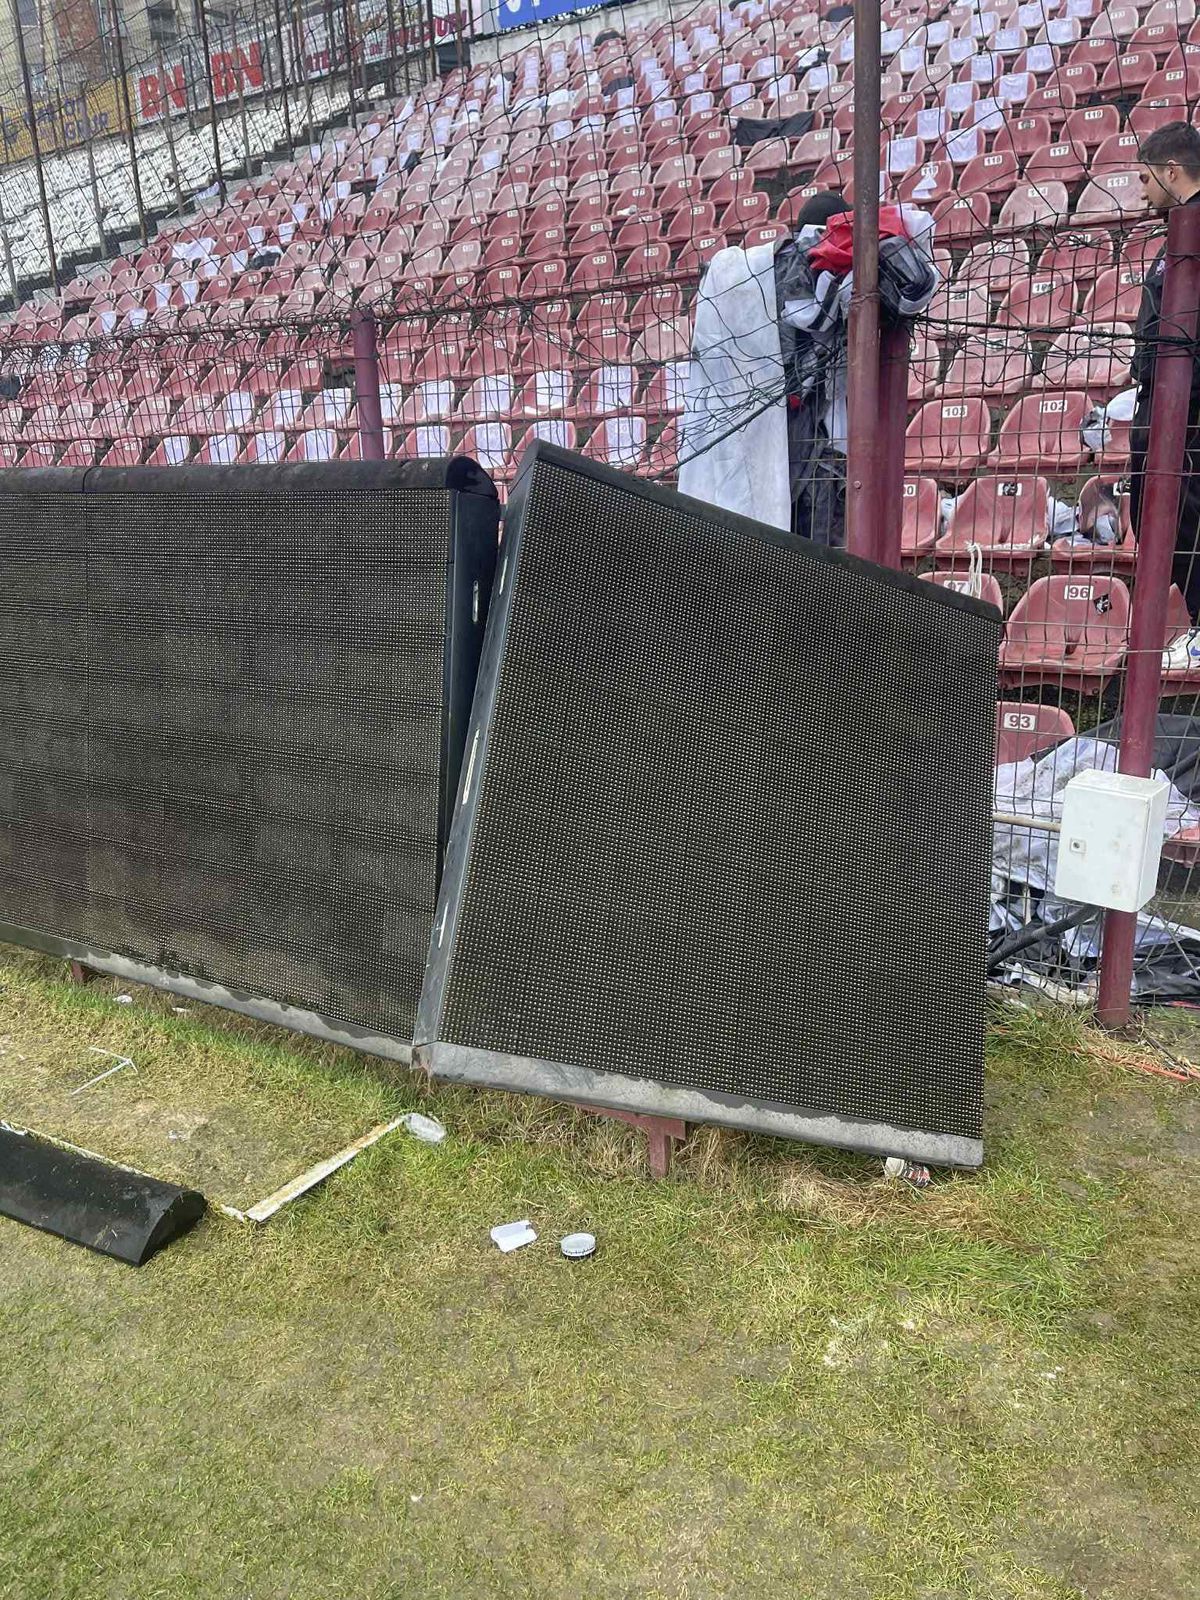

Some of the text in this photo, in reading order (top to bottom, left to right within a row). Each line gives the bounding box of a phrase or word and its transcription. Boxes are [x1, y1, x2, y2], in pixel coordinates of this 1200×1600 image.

[1086, 111, 1101, 119] 119
[1051, 147, 1067, 156] 117
[1068, 586, 1090, 599] 96
[1009, 715, 1031, 728] 93
